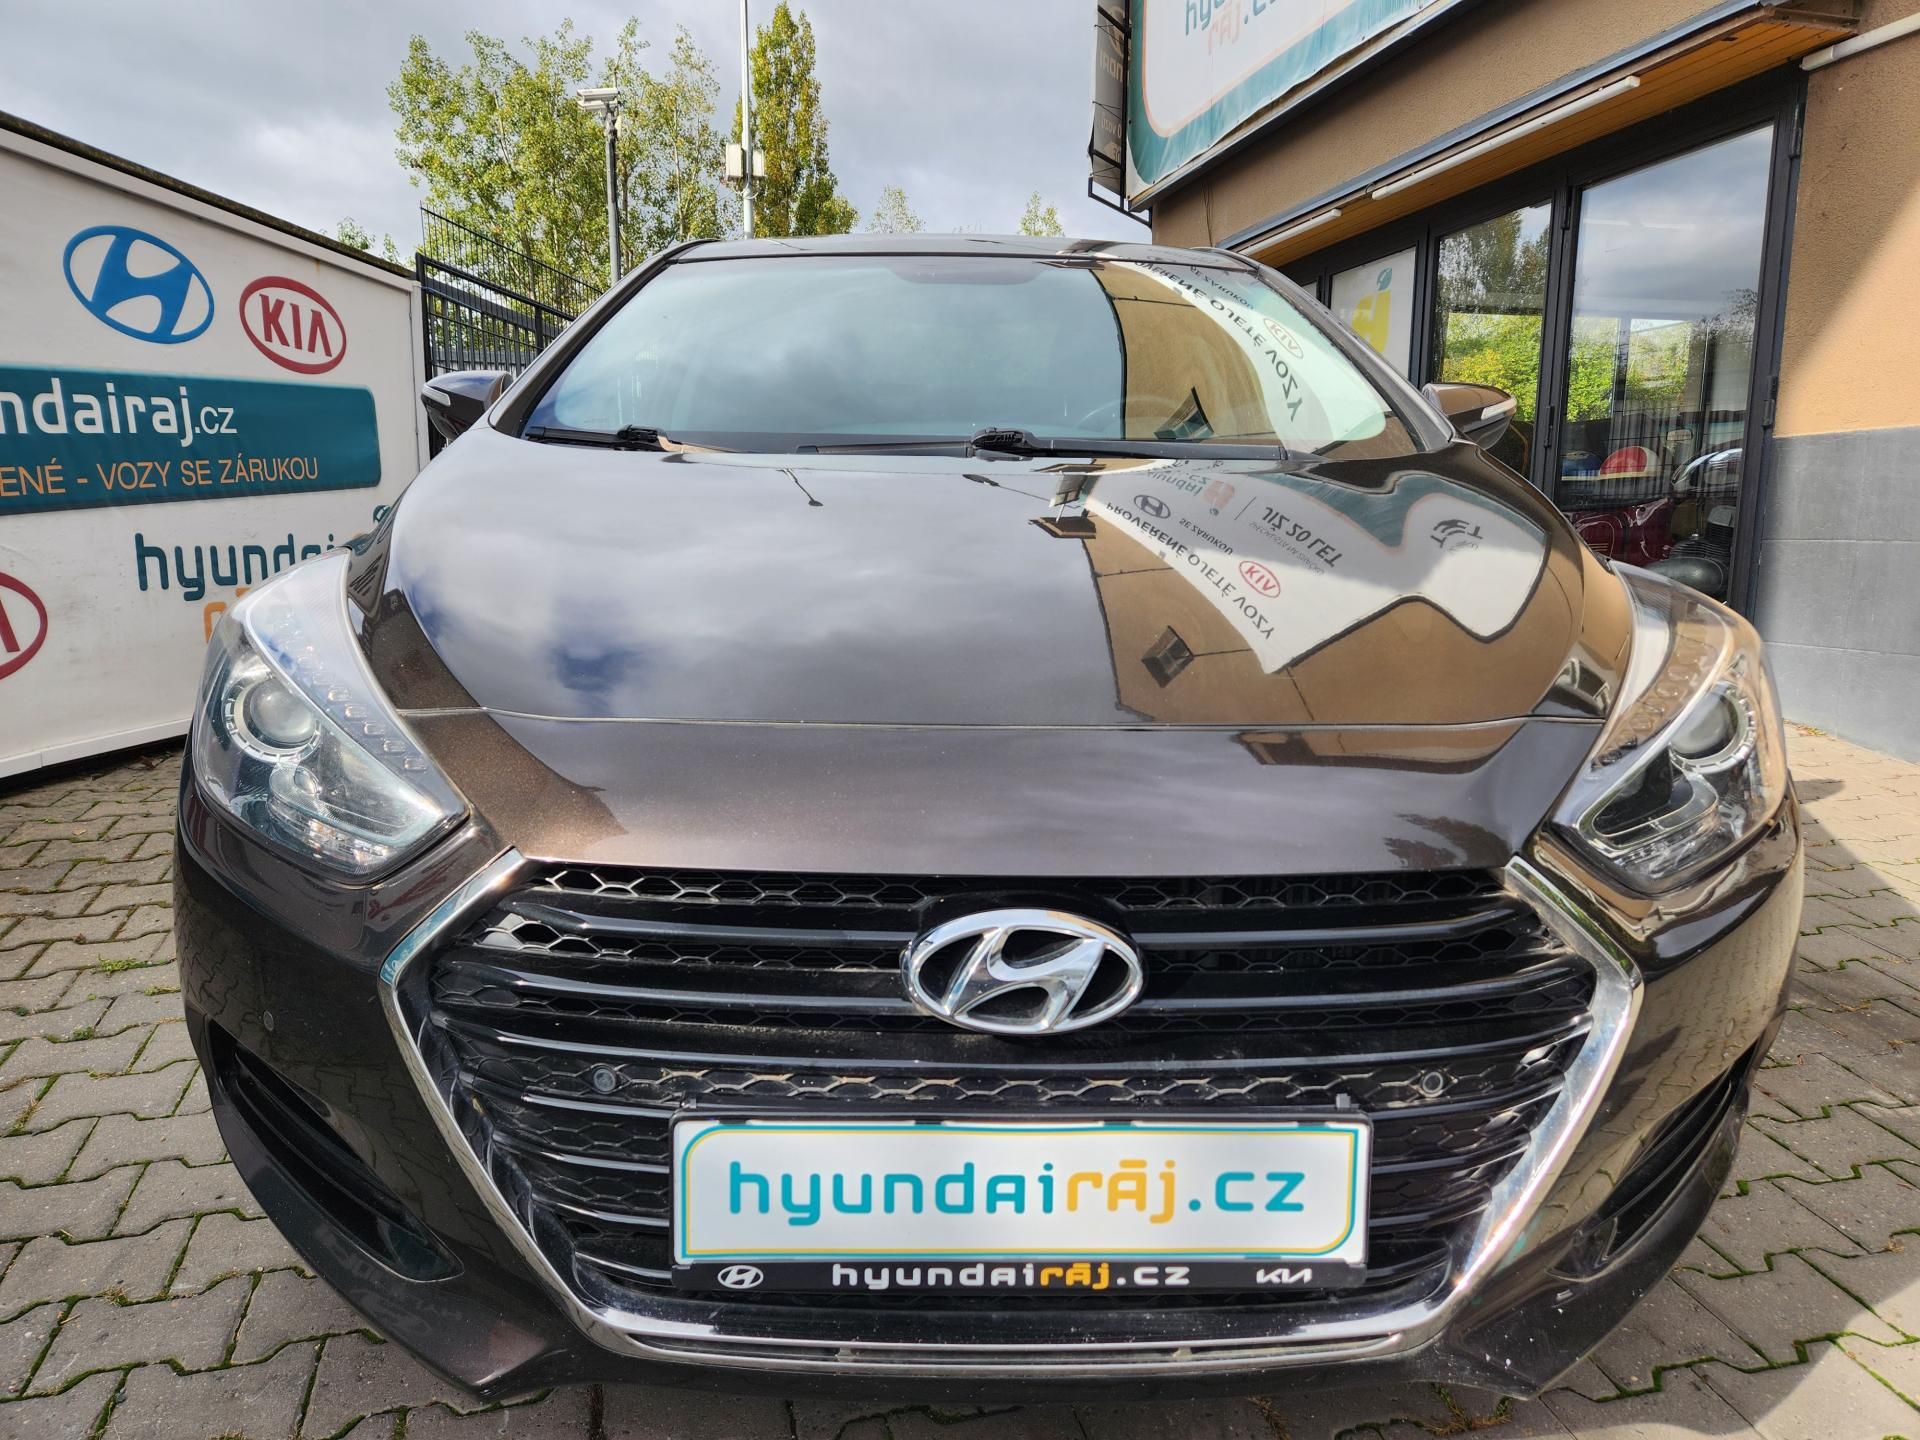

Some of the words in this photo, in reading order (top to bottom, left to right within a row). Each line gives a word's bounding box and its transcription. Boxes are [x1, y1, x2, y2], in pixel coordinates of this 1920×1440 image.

[258, 294, 333, 358] KIA
[96, 461, 171, 490] VOZY
[180, 460, 213, 486] SE
[218, 453, 319, 484] ZÁRUKOU
